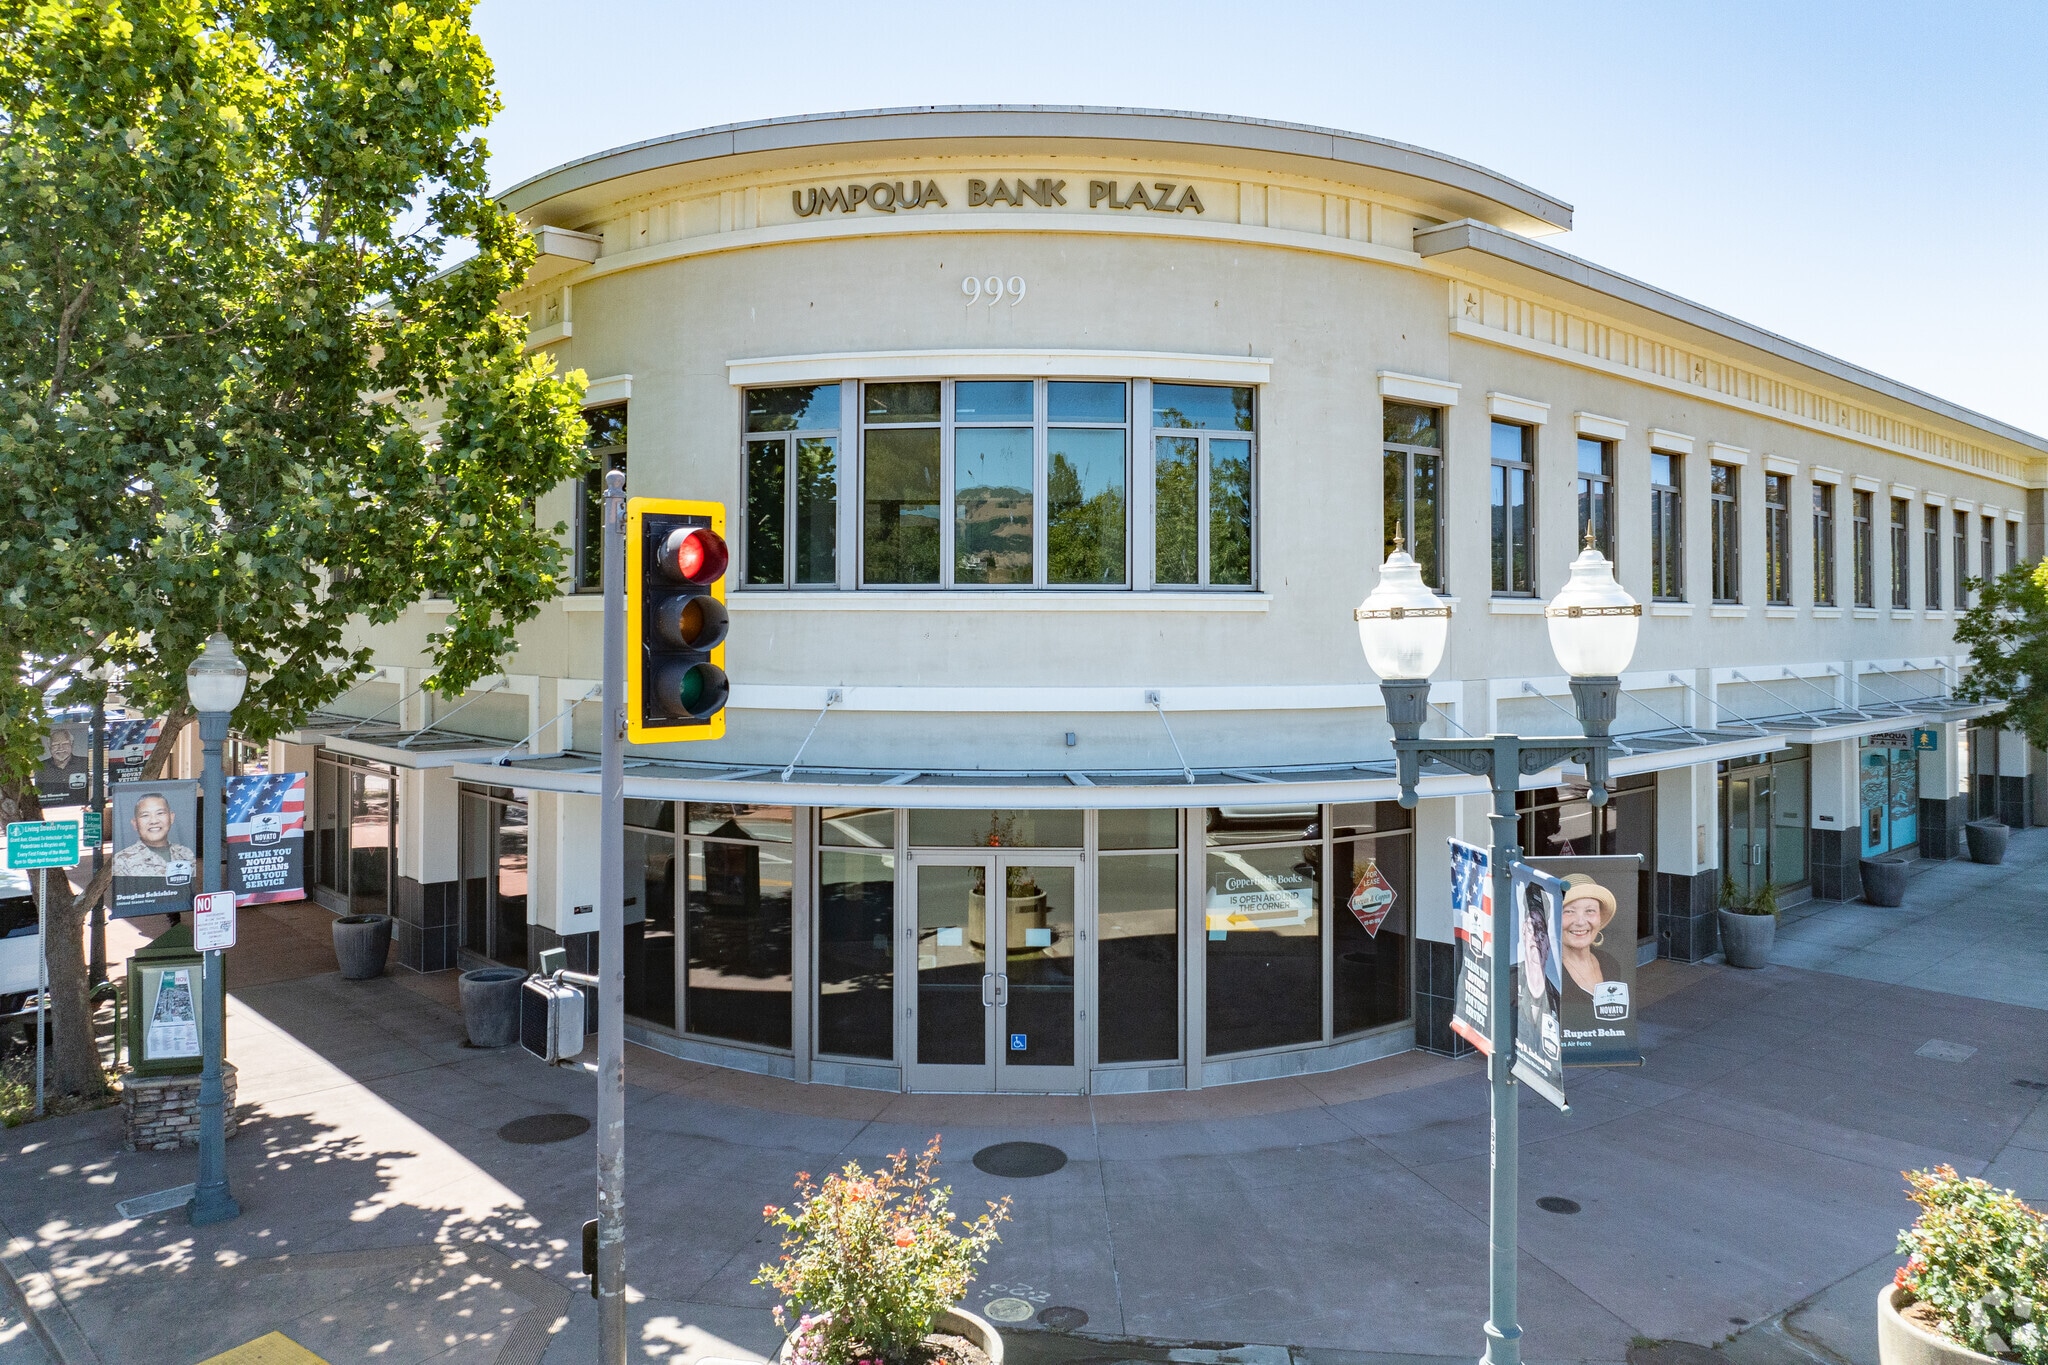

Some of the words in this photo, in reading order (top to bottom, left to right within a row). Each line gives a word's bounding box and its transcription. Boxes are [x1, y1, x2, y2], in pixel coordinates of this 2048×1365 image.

[792, 178, 948, 217] UMPQUA
[968, 178, 1067, 208] BANK
[1090, 180, 1206, 215] PLAZA
[961, 276, 1027, 308] 999
[238, 850, 271, 859] THANK
[246, 856, 284, 866] NOVATO
[240, 863, 289, 874] VETERANS
[262, 871, 288, 879] YOUR
[246, 878, 284, 888] SERVICE
[1226, 875, 1276, 891] Copperfield's
[1277, 874, 1302, 883] Books
[1364, 878, 1380, 886] LEASE
[1239, 895, 1262, 904] OPEN
[1263, 892, 1299, 902] AROUND
[197, 898, 211, 912] NO
[1257, 902, 1290, 910] CORNER
[1600, 1006, 1623, 1014] NOVATO
[1563, 1029, 1597, 1039] Rupert
[1598, 1028, 1625, 1036] Behm
